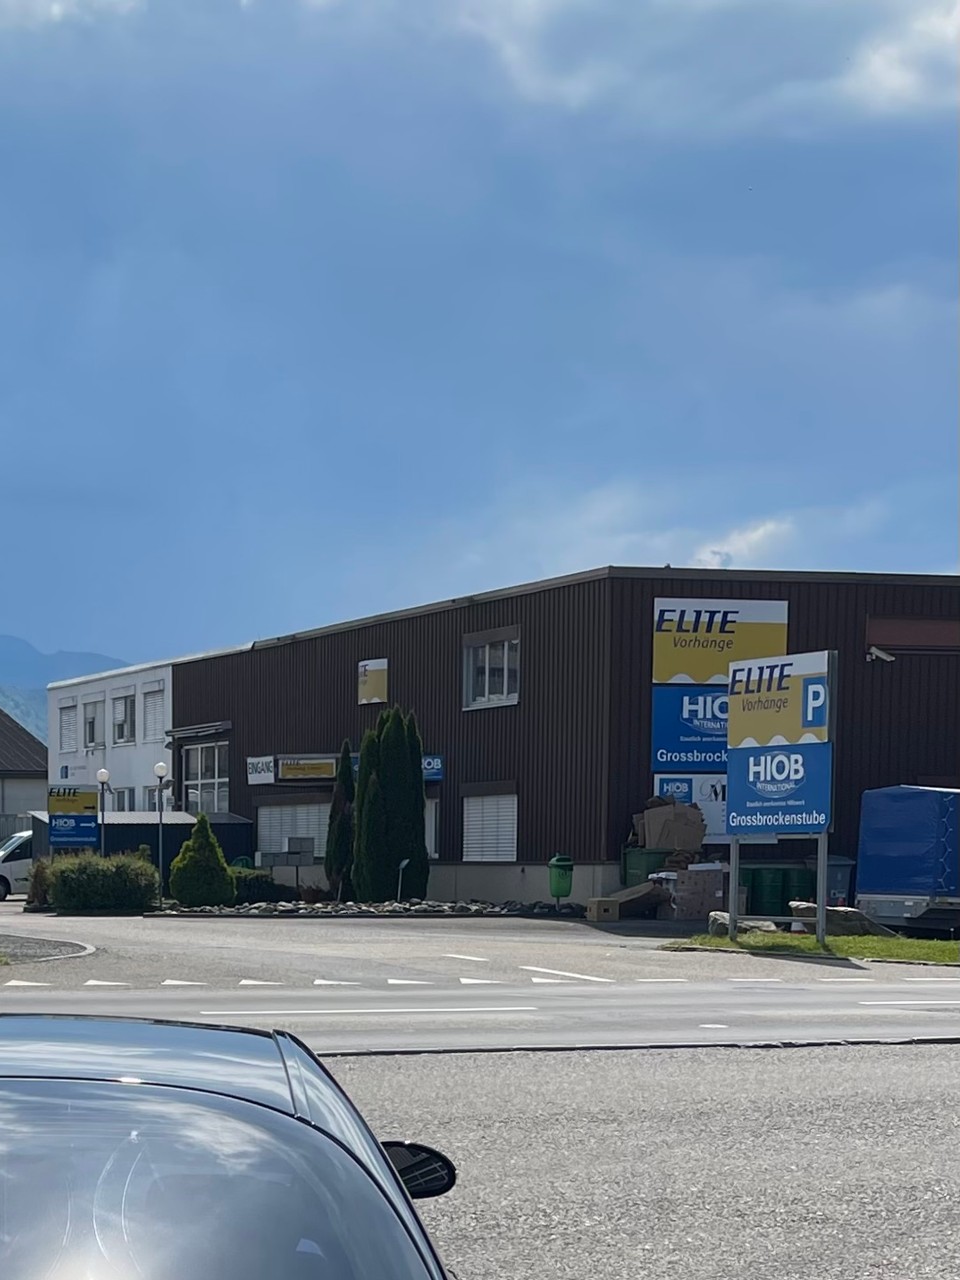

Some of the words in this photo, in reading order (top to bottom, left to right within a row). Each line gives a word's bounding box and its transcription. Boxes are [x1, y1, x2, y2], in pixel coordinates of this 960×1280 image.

[655, 609, 739, 634] ELITE
[673, 636, 734, 652] Vorhänge
[730, 662, 793, 696] ELITE
[682, 696, 728, 719] HIO
[742, 697, 789, 713] Vorhänge
[807, 684, 825, 721] P
[693, 718, 728, 730] INTERNATI
[657, 749, 728, 762] Grossbrock
[748, 754, 804, 782] HIOB
[49, 787, 81, 798] ELITE
[663, 782, 689, 792] HIOB
[729, 810, 826, 827] Grossbrockenstube
